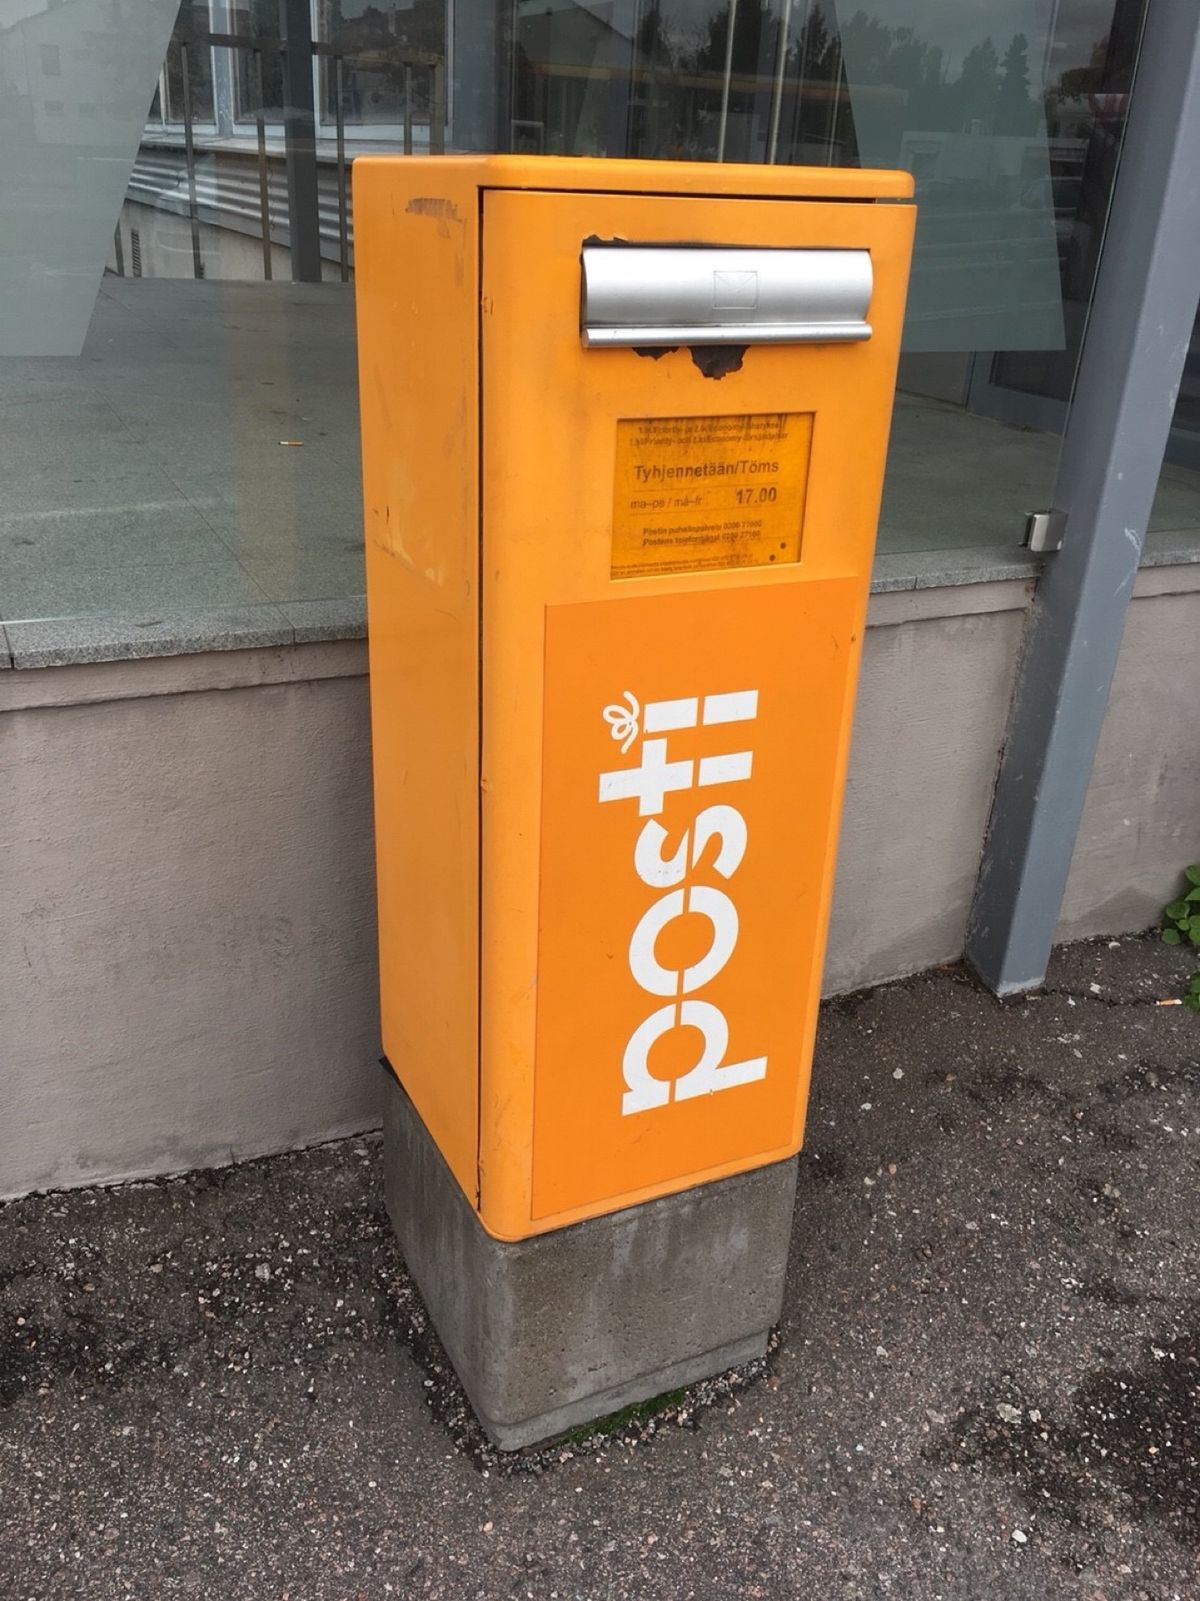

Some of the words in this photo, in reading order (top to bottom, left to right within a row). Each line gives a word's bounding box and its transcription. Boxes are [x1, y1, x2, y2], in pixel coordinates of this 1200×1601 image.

[634, 460, 779, 484] Tyhjennetään/Töms
[736, 486, 777, 505] 17.00
[598, 690, 767, 1117] posti
